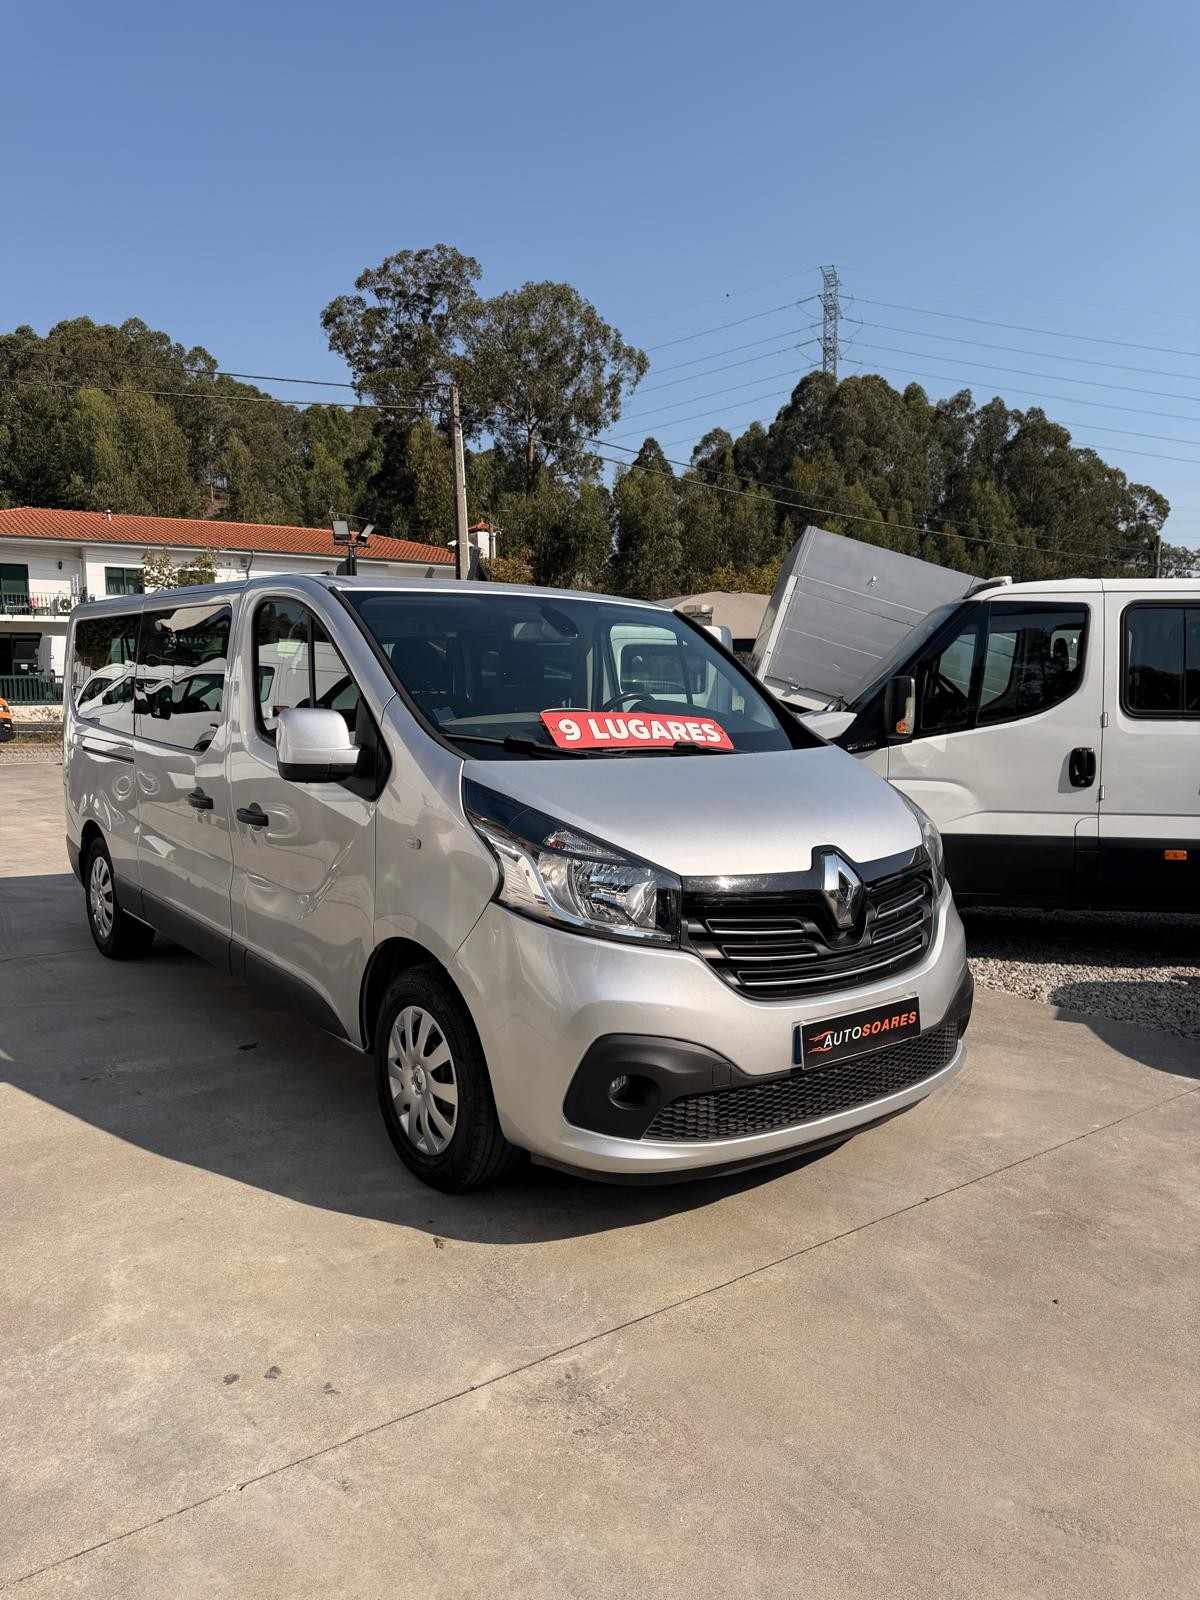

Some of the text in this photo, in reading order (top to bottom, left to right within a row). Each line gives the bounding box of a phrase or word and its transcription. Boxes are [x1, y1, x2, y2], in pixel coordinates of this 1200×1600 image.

[558, 718, 721, 742] 9 LUGARES
[823, 1011, 917, 1048] AUTOSOARES
